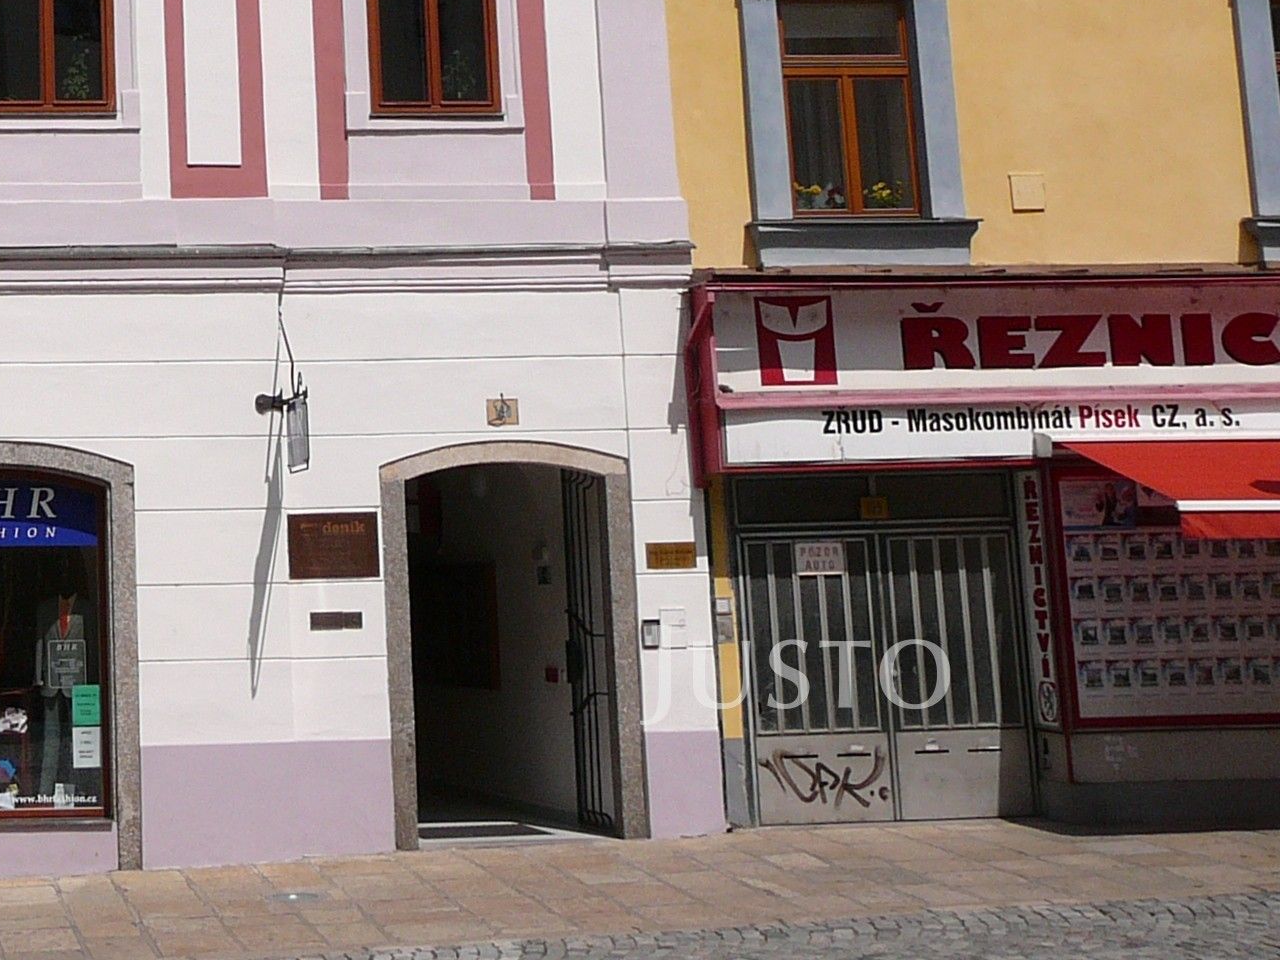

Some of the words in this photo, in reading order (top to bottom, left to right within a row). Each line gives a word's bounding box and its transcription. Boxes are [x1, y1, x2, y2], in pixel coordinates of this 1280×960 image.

[900, 302, 1280, 370] ŘEZNIC
[821, 405, 883, 434] ZŘUD
[907, 405, 1072, 433] Masokombinát
[1078, 403, 1141, 429] Písek
[1151, 404, 1187, 429] CZ,
[1195, 407, 1214, 427] a.
[1222, 407, 1240, 427] s.
[800, 546, 839, 558] POZOR
[805, 560, 835, 571] AUTO
[1023, 476, 1051, 679] ŘEZNICTVÍ
